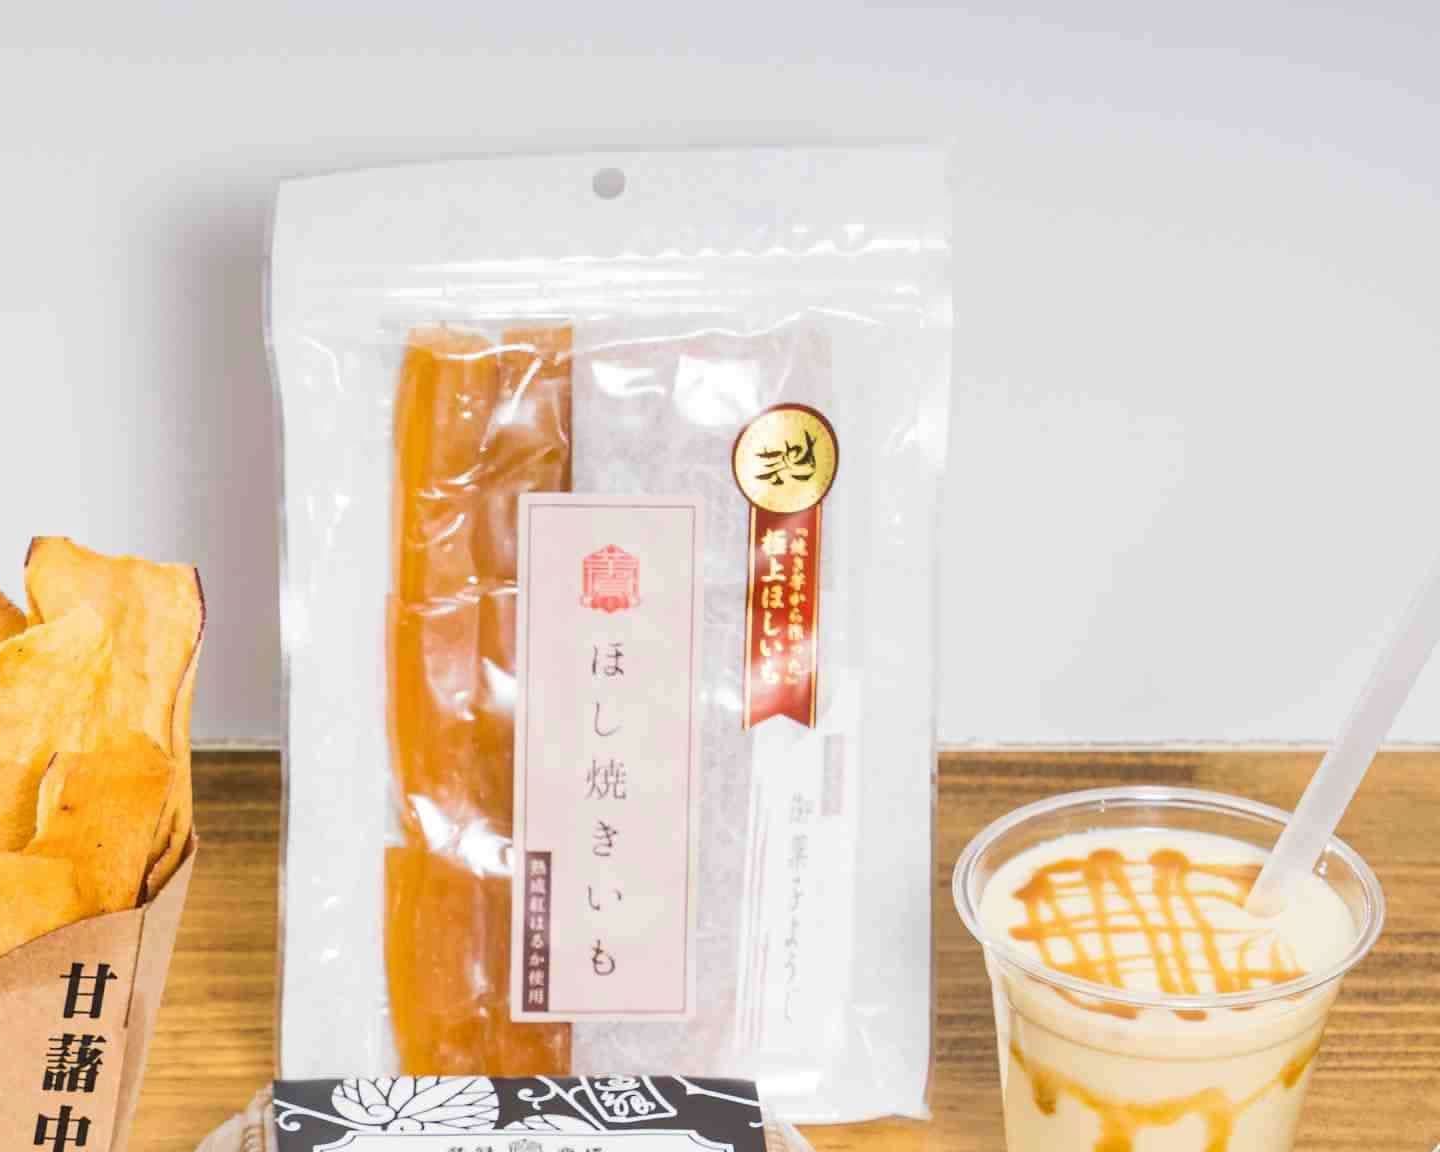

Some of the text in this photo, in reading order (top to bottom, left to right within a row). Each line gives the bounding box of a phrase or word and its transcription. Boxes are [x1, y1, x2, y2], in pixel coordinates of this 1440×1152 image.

[585, 643, 628, 976] ほし焼きいも
